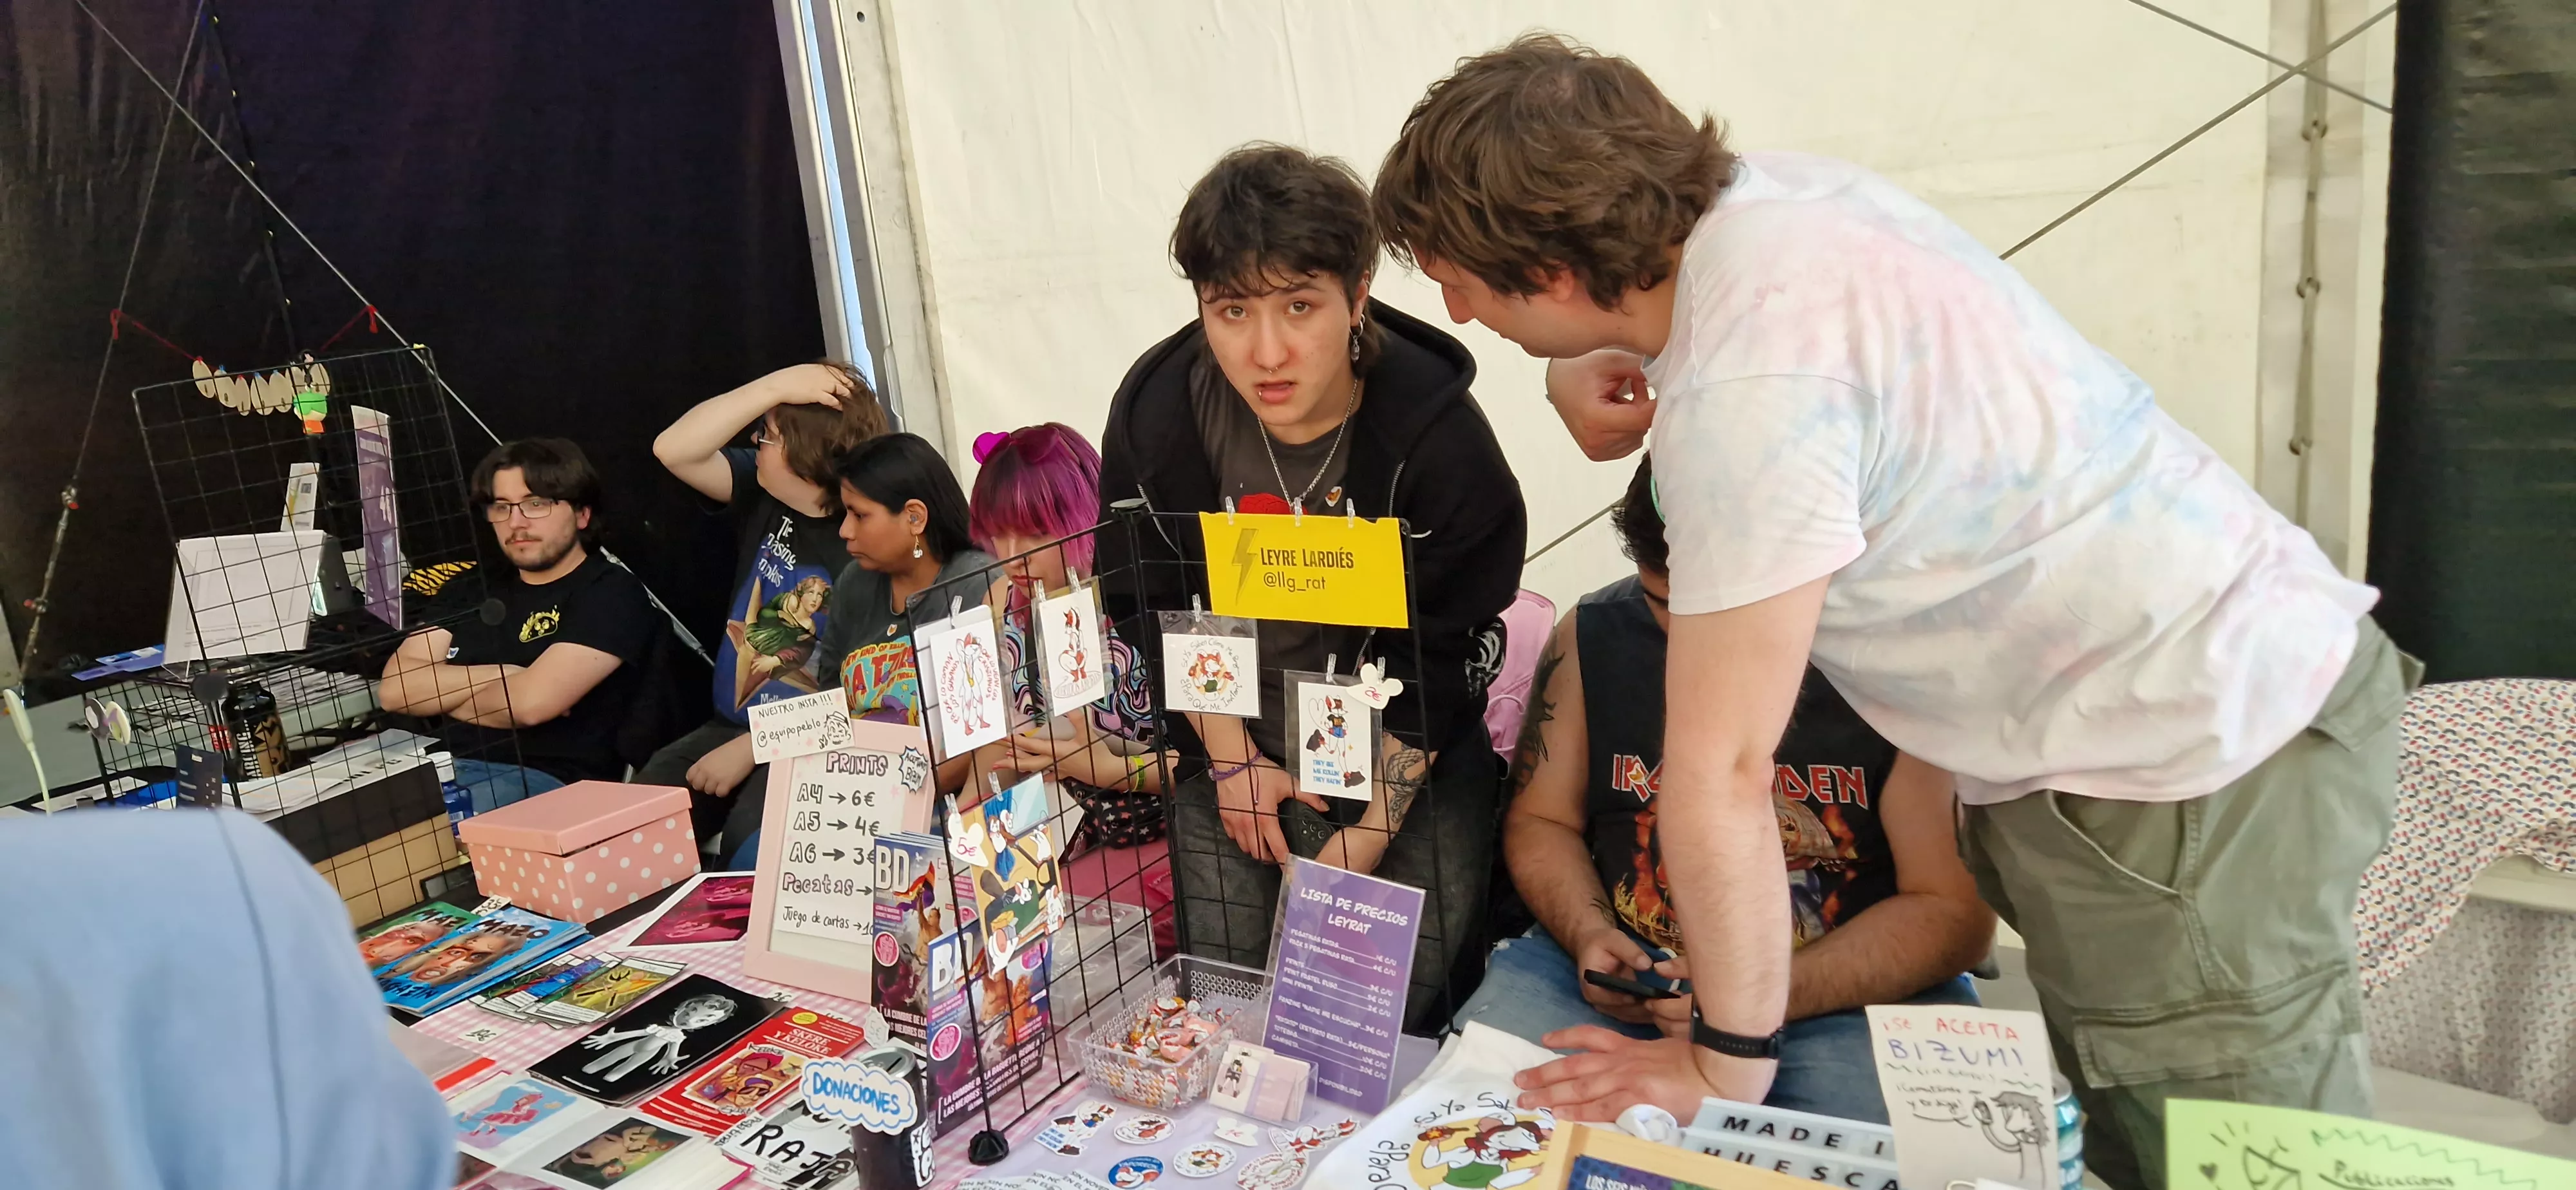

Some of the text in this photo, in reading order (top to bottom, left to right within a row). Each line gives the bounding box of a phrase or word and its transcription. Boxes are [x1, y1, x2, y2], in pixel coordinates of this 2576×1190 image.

[1260, 547, 1354, 569] LEYRE LARDIÉS
[1264, 571, 1326, 592] @llg_rat
[759, 704, 794, 719] NUESTRO
[798, 698, 818, 710] INSTA
[826, 751, 889, 777] PRINTS
[797, 783, 876, 807] A4 6€
[1772, 764, 1868, 810] DEN
[793, 811, 880, 837] A5 4€
[789, 842, 817, 864] A6
[956, 838, 977, 856] 5€
[875, 845, 910, 893] BD
[783, 906, 807, 928] Juego
[811, 910, 821, 923] de
[823, 915, 849, 929] cartas
[1301, 887, 1408, 926] LISTA DE PRECIOS
[1328, 914, 1372, 934] LEYRAT
[378, 978, 439, 999] AGAZIN
[773, 1031, 832, 1055] Y KELOKE
[790, 1028, 831, 1045] SKERE
[1722, 1115, 1884, 1156] MADE I
